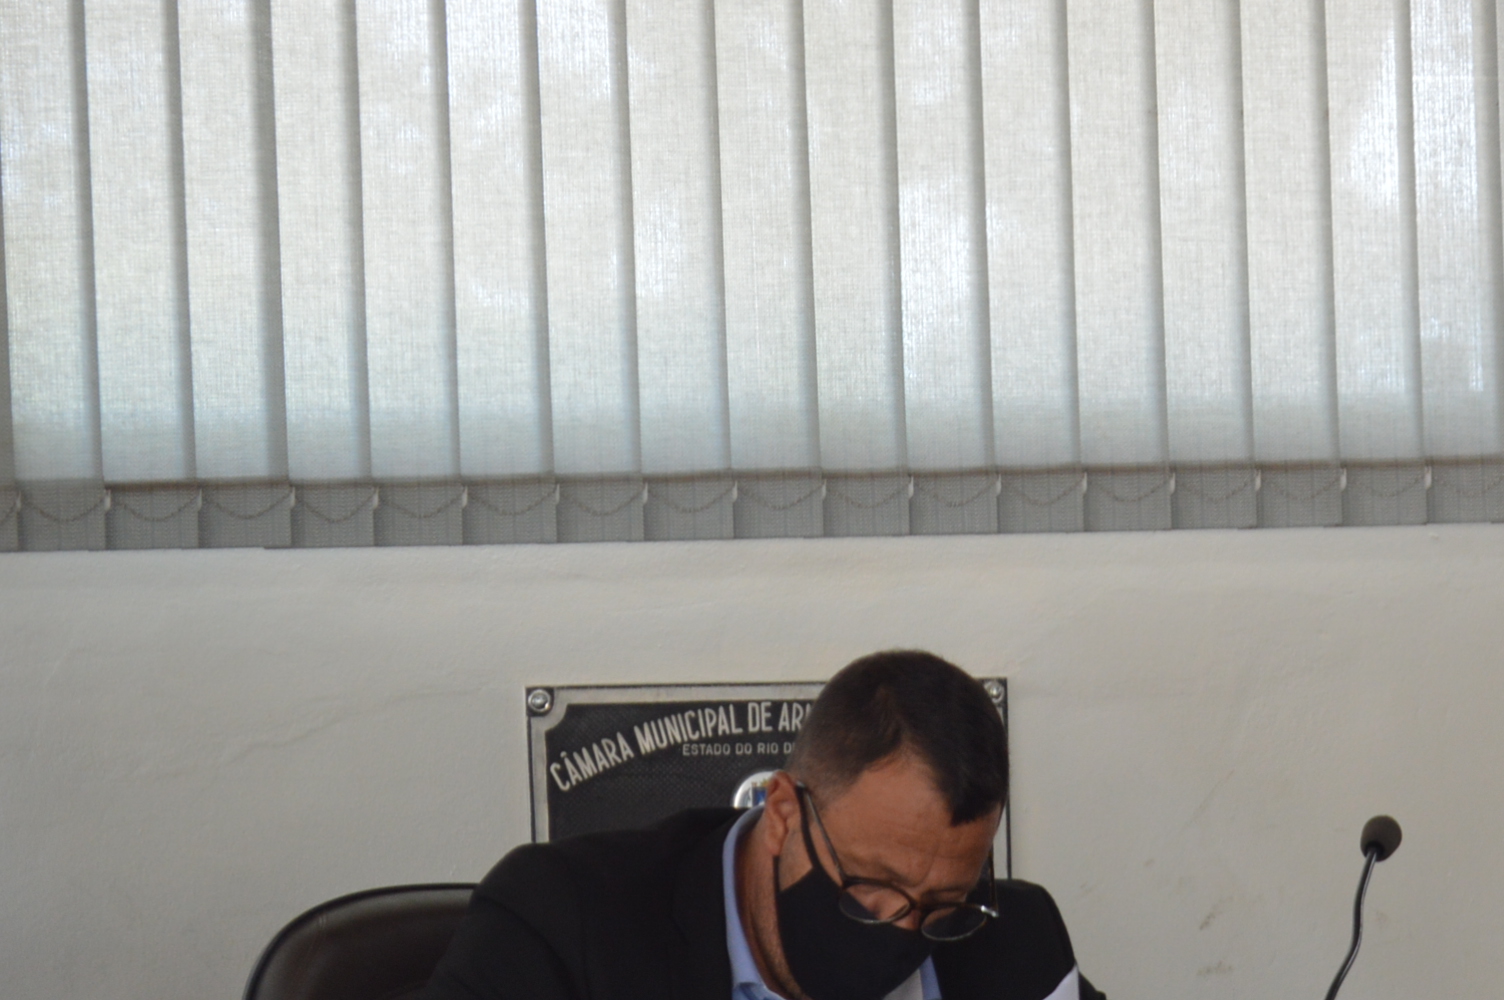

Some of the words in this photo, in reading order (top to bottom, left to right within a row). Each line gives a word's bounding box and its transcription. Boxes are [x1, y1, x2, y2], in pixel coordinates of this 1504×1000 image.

[550, 732, 634, 792] CÂMARA
[634, 703, 743, 756] MUNICIPAL
[748, 701, 773, 732] DE
[682, 743, 730, 756] ESTADO
[735, 743, 752, 756] DO
[757, 742, 779, 755] RIO
[783, 742, 795, 755] D
